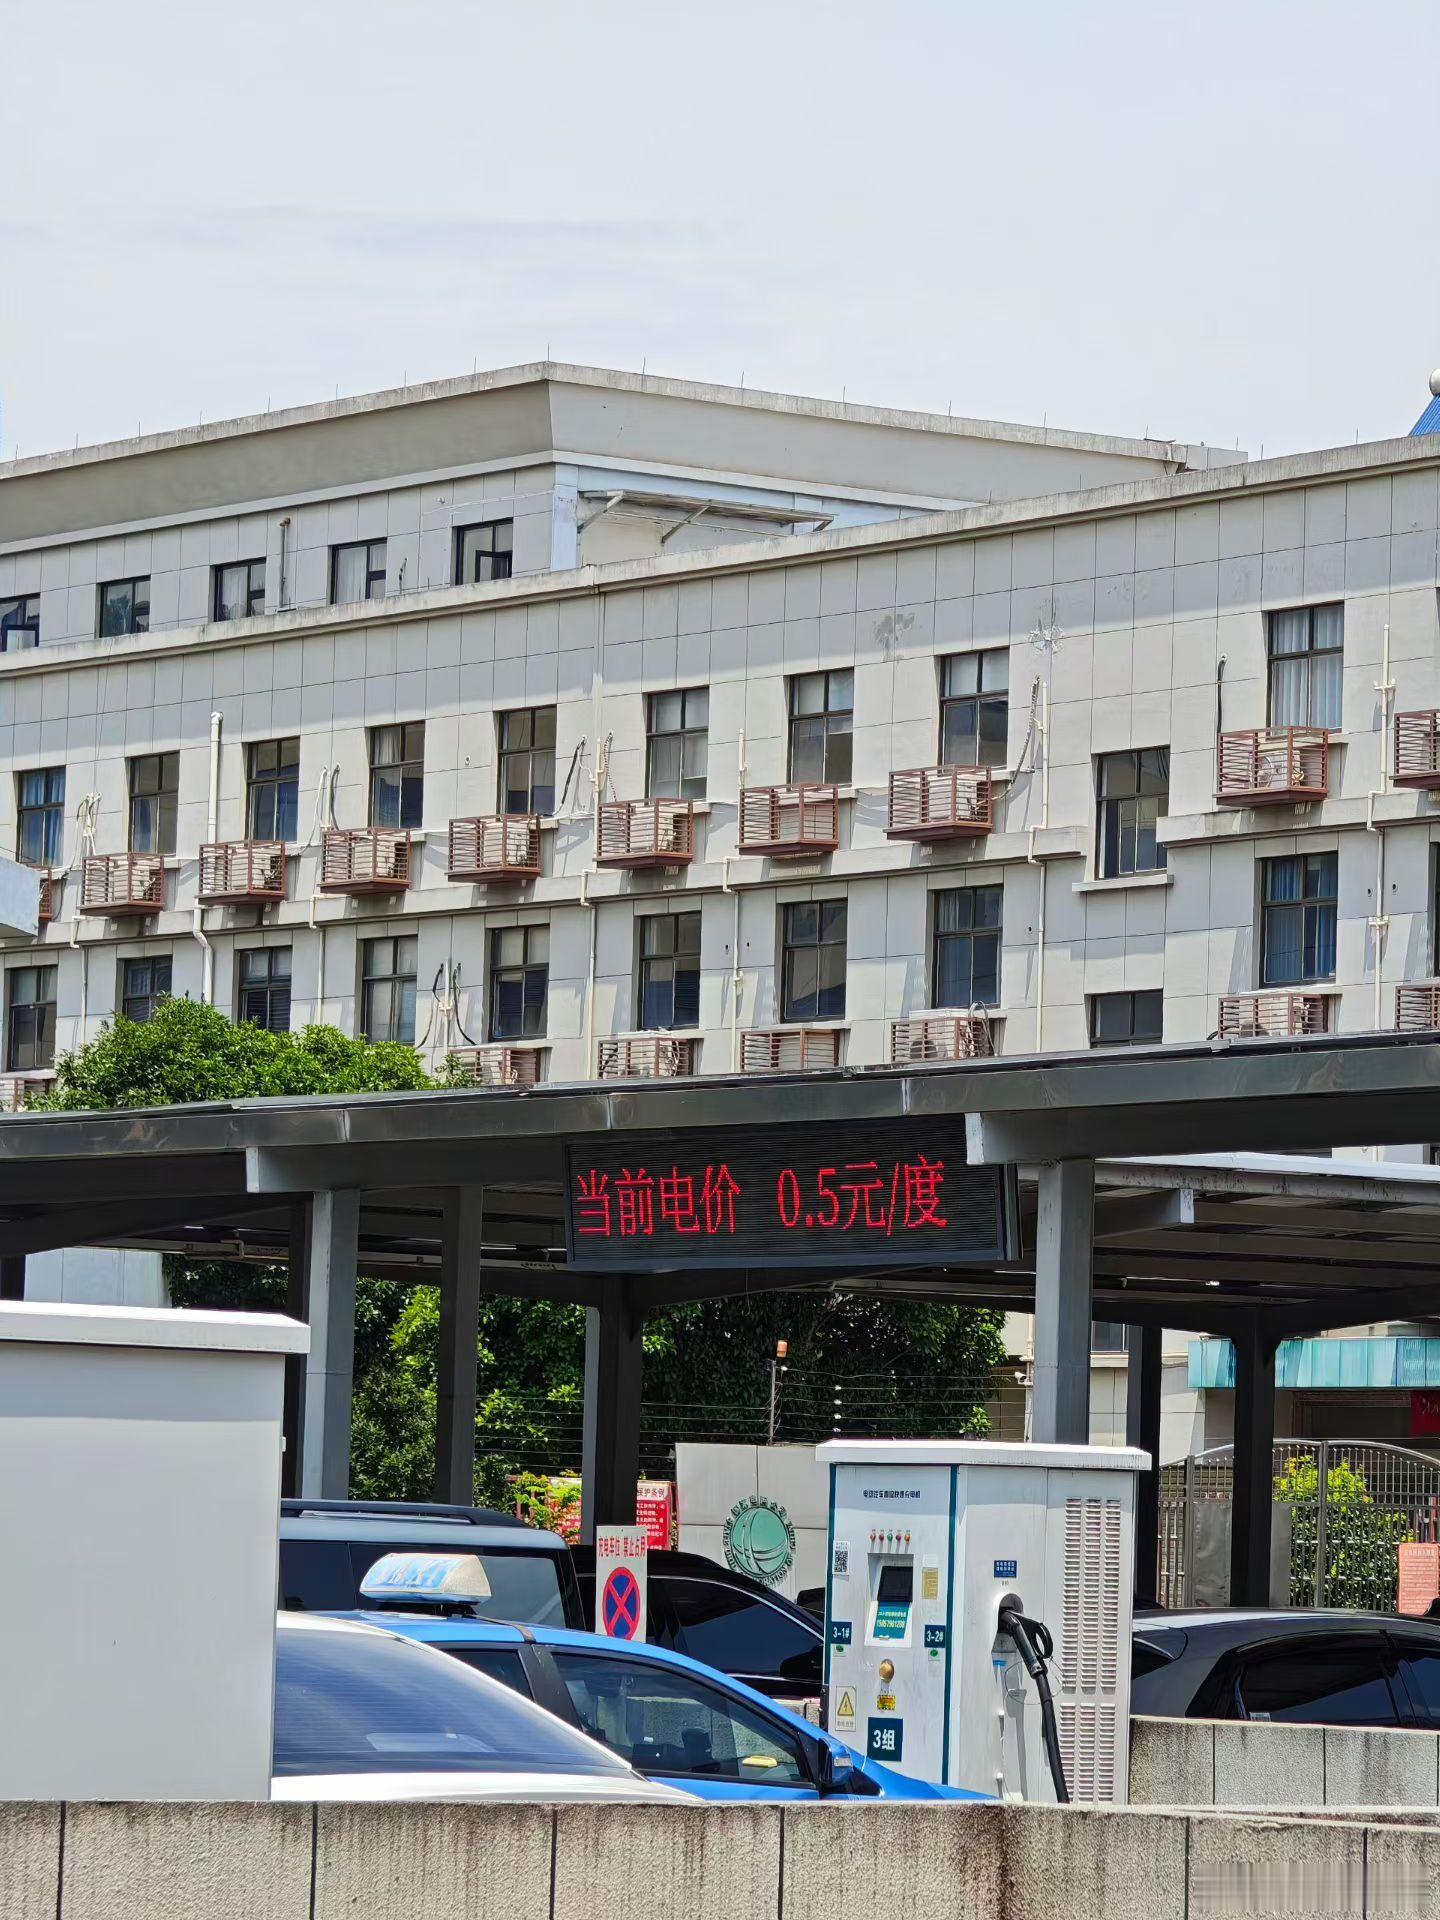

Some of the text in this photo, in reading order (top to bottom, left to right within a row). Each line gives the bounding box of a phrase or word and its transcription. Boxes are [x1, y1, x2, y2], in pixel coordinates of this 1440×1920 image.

[577, 1153, 948, 1236] 当前电价 0.5元/度
[598, 1535, 646, 1558] 充电车位 禁止占用
[832, 1626, 850, 1639] 3-1#
[926, 1630, 944, 1642] 3-2#
[873, 1729, 895, 1751] 3组
